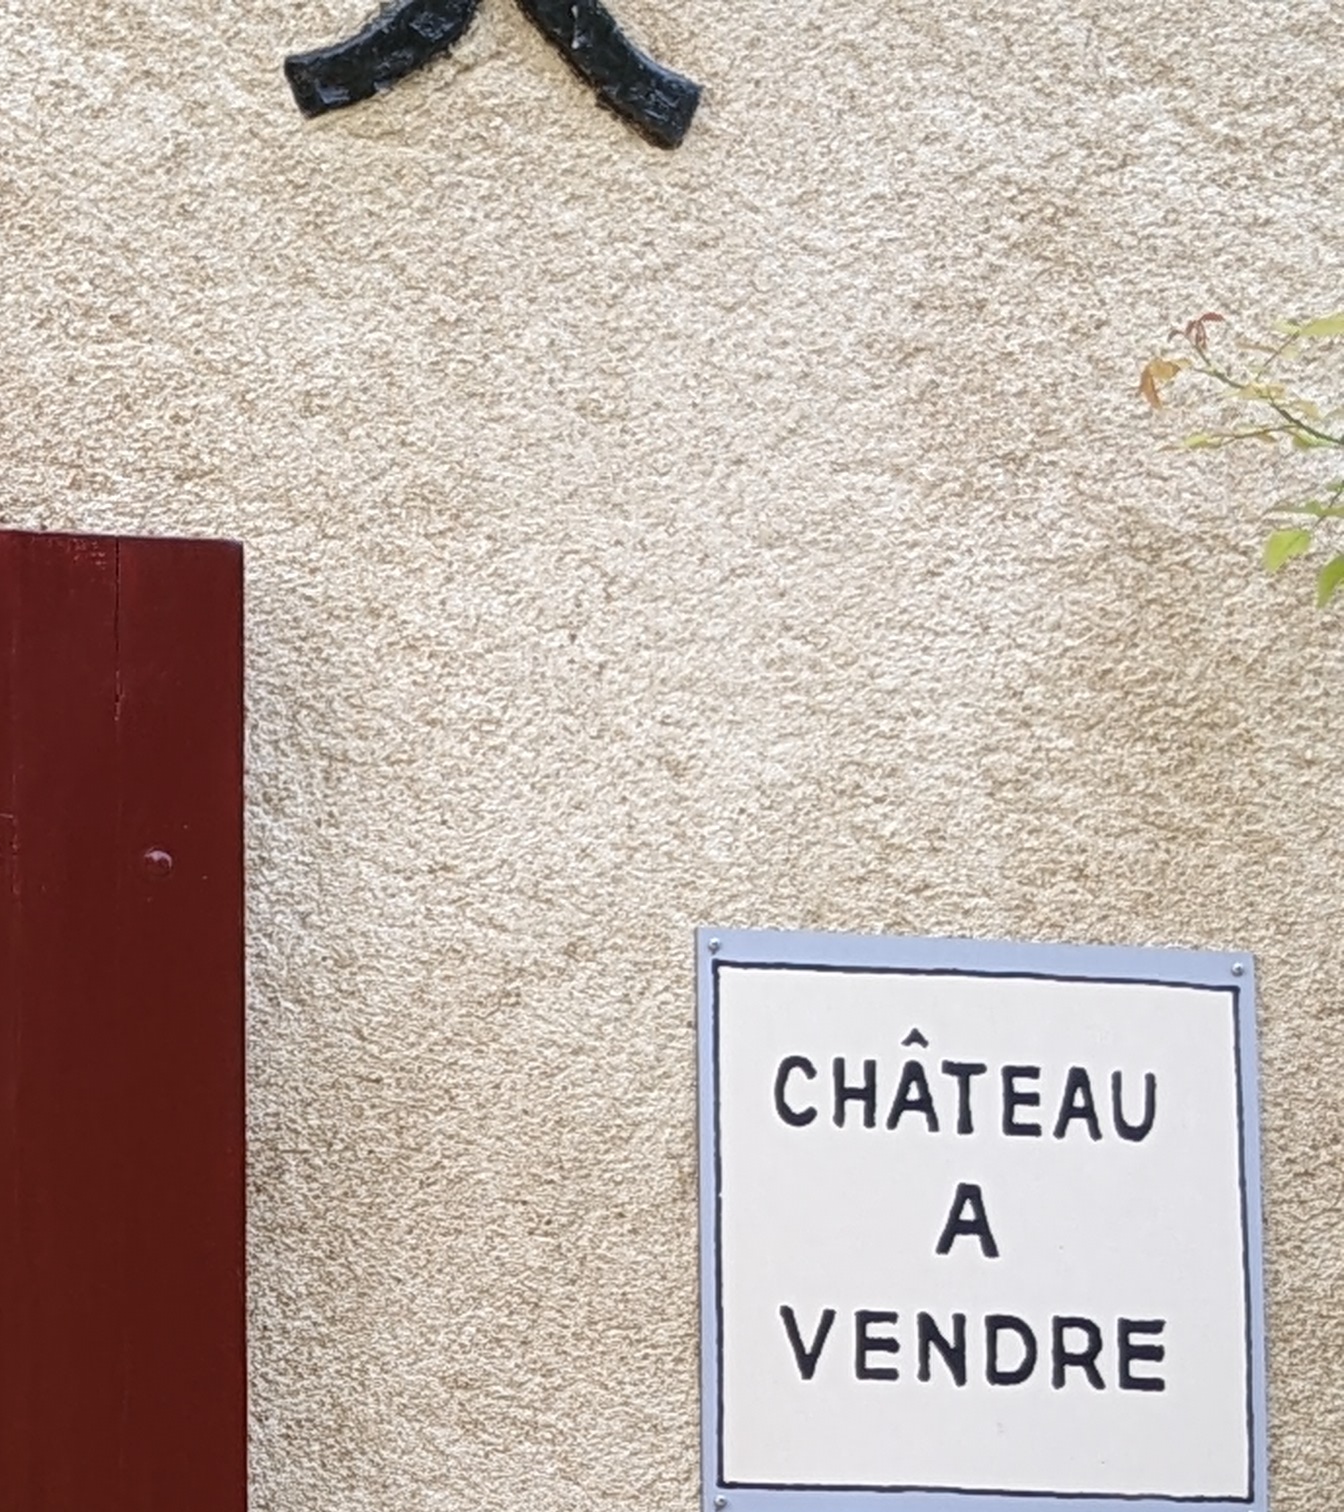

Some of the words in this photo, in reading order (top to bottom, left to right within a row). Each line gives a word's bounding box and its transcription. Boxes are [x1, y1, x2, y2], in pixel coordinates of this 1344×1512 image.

[773, 1027, 1157, 1143] CHÂTEAU
[935, 1182, 1000, 1259] A
[779, 1305, 1166, 1392] VENDRE
